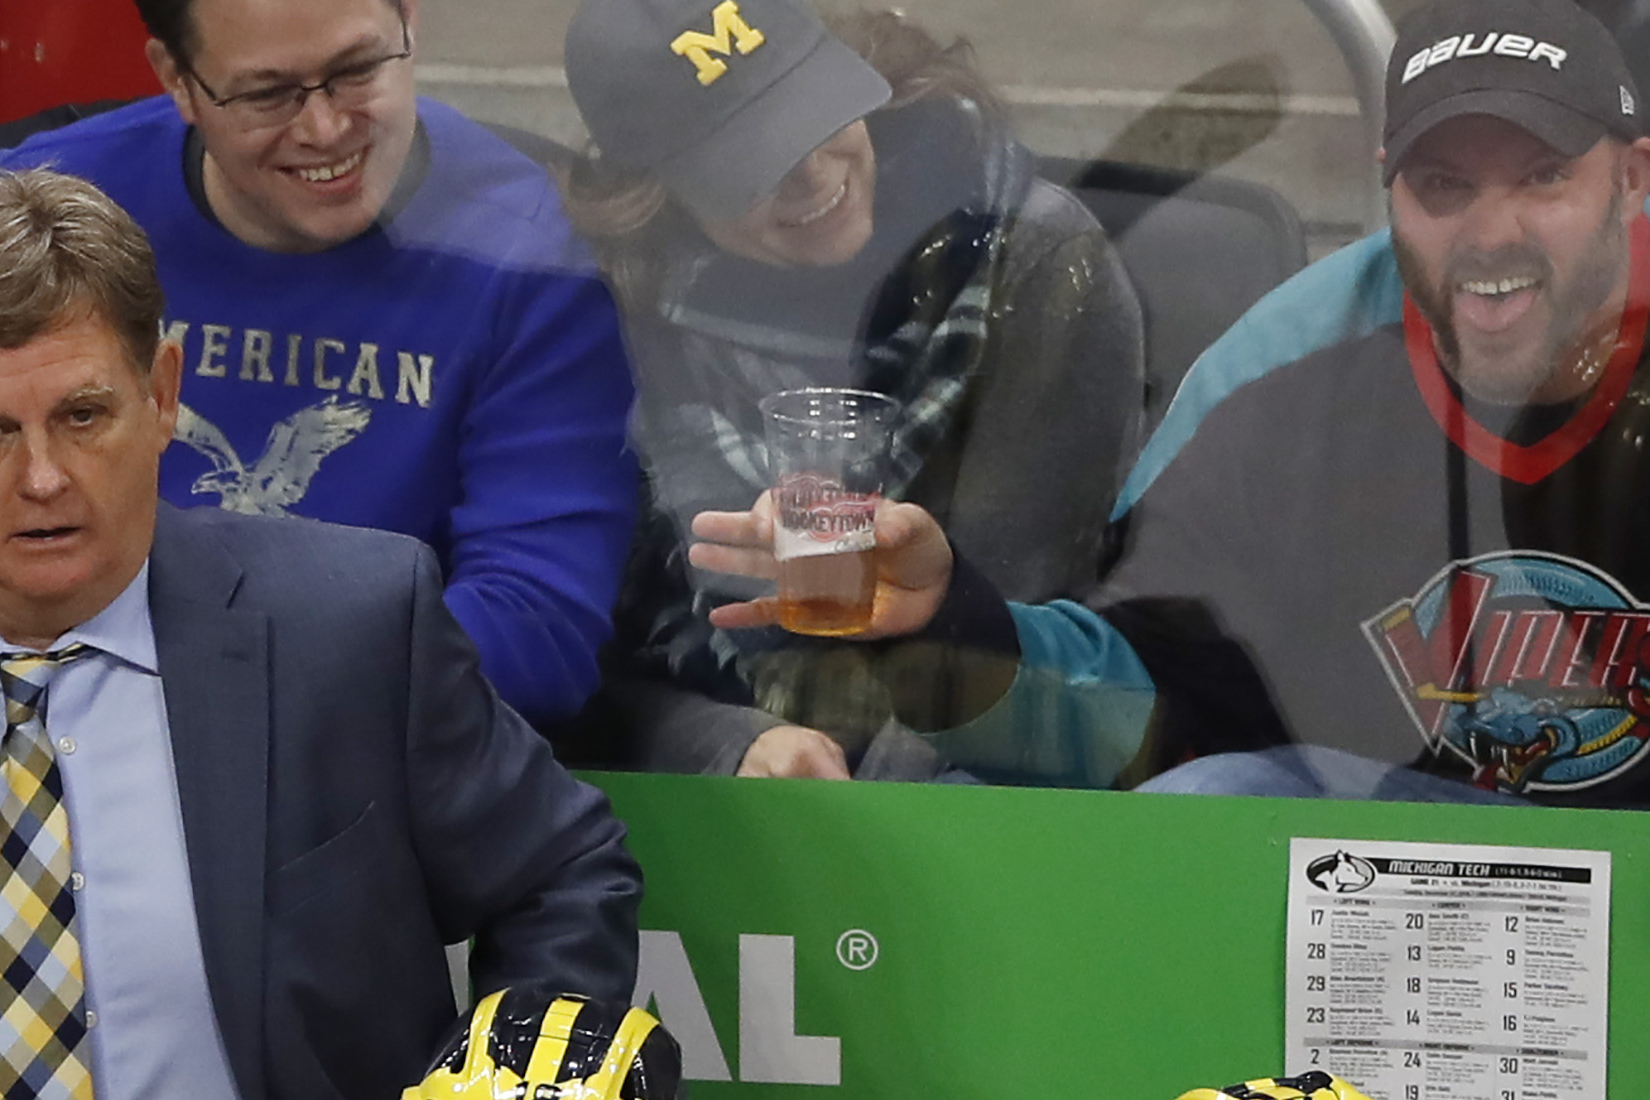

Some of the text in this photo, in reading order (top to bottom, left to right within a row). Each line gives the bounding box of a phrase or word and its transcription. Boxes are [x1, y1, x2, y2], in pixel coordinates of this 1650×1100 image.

[670, 0, 766, 87] M
[1402, 32, 1568, 84] BAUER
[1389, 861, 1454, 875] MICHIGAN
[1458, 863, 1490, 876] TECH
[1311, 909, 1324, 926] 17
[1405, 913, 1424, 930] 20
[1505, 915, 1519, 932] 12
[1307, 943, 1326, 959] 28
[1407, 945, 1421, 961] 13
[1506, 949, 1515, 966] 9
[1307, 975, 1326, 991] 29
[1407, 977, 1421, 993] 18
[1503, 982, 1517, 998] 15
[1307, 1007, 1325, 1023] 23
[1406, 1009, 1420, 1025] 14
[1503, 1015, 1517, 1031] 16
[1310, 1048, 1320, 1064] 2
[1404, 1052, 1421, 1068] 24
[1499, 1057, 1518, 1074] 30
[1405, 1085, 1419, 1100] 19
